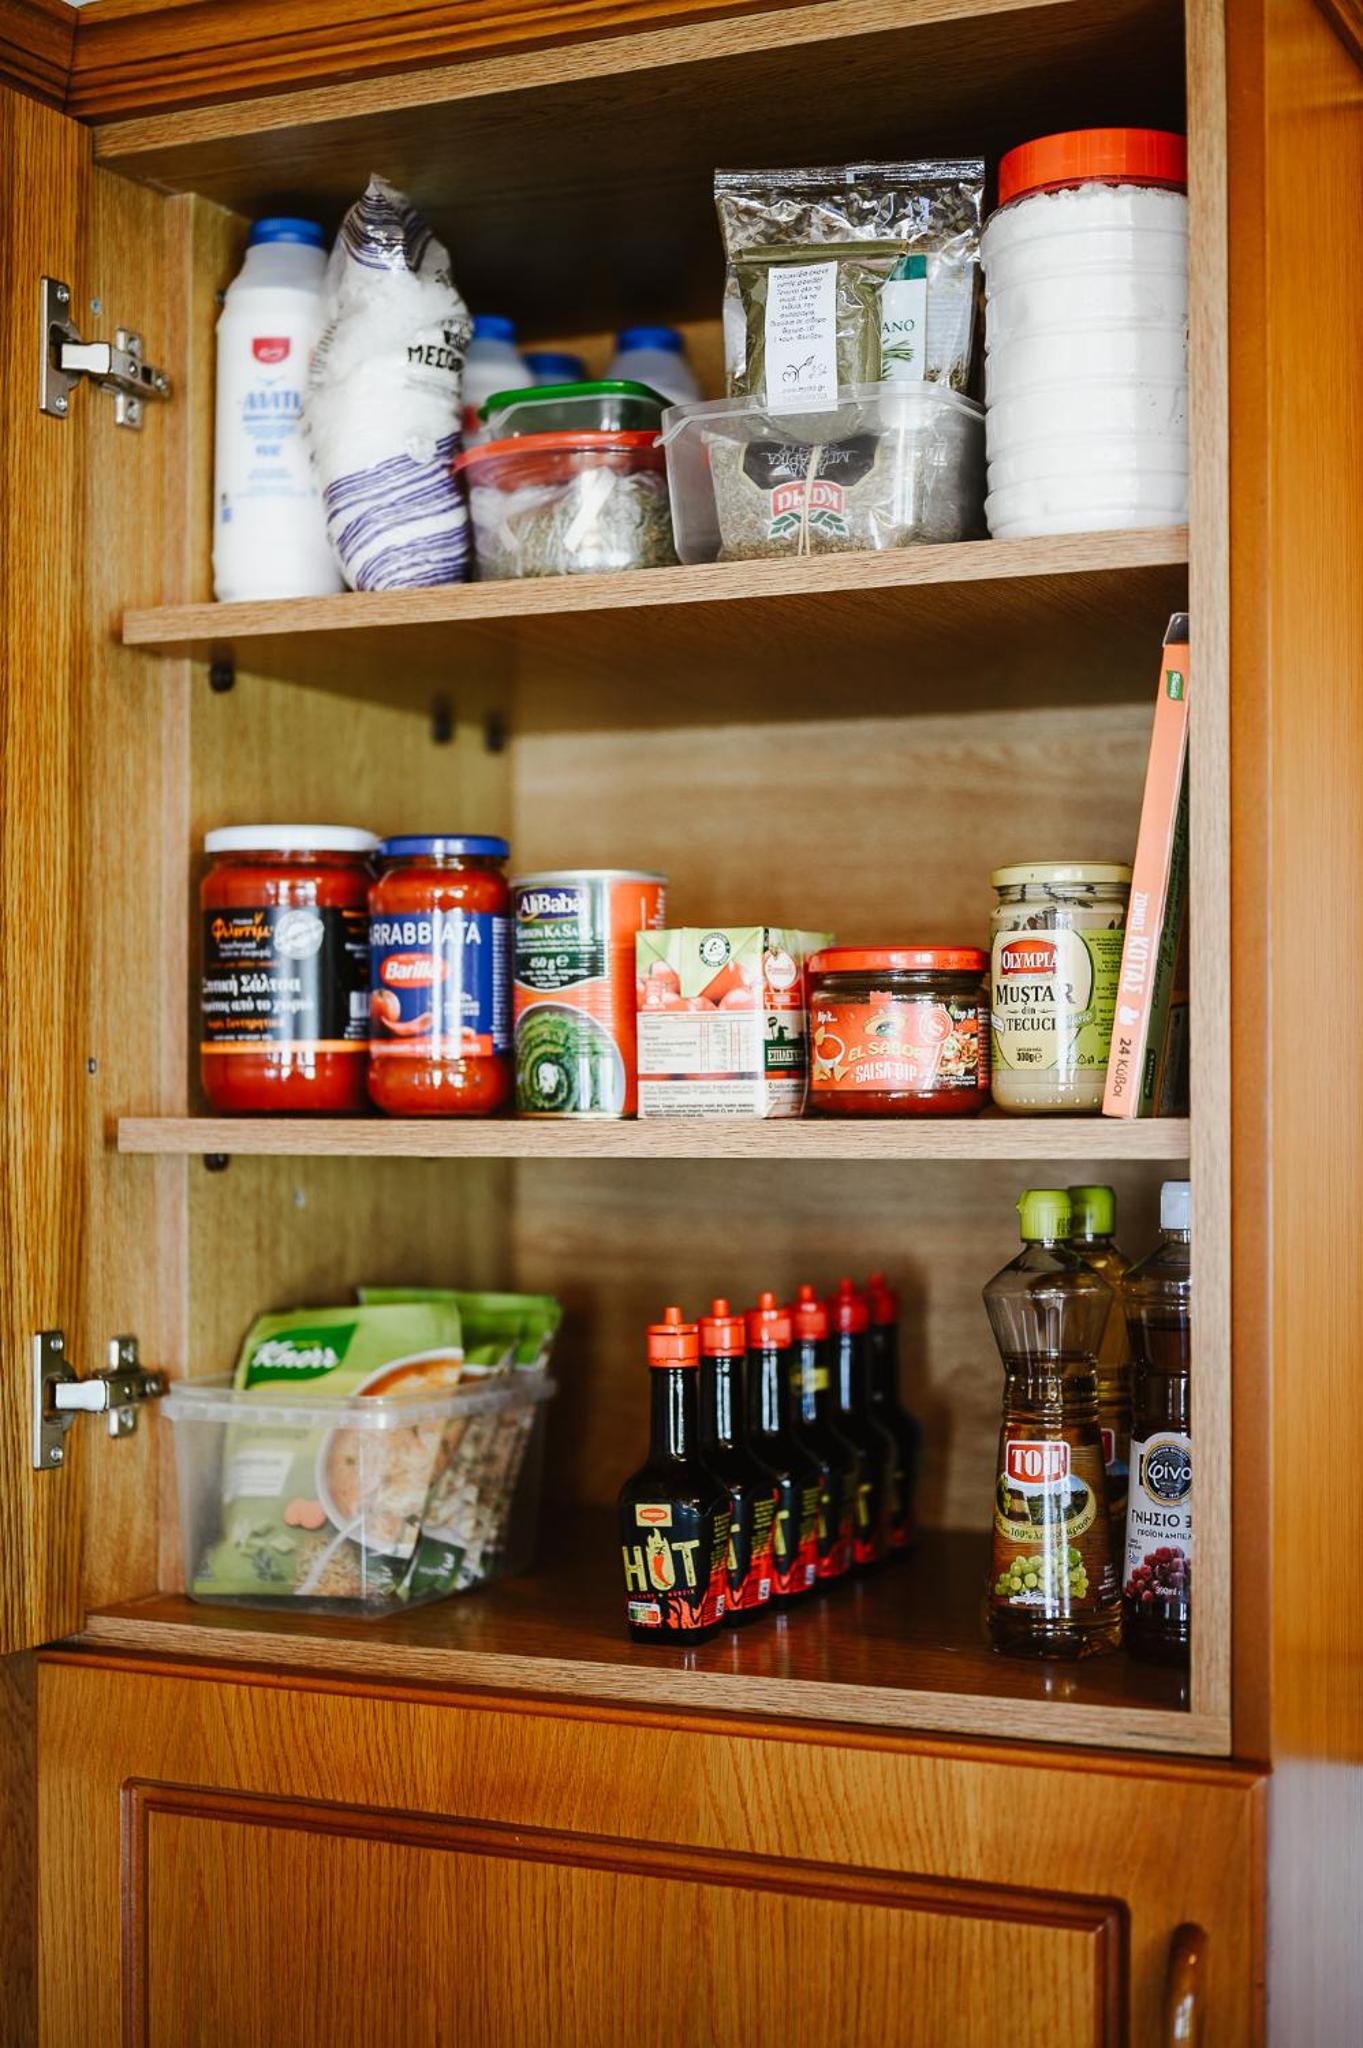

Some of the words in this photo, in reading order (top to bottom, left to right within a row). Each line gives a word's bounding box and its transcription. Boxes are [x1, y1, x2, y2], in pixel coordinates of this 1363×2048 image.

[1123, 935, 1150, 995] ΚΟΤΑΣ
[1021, 1006, 1037, 1015] din
[1006, 1018, 1057, 1032] TECUCI
[1119, 1037, 1131, 1054] 24
[855, 1062, 892, 1083] SALSA
[1131, 1509, 1180, 1528] ΓΝΗΣΙΟ
[622, 1528, 700, 1592] HOT
